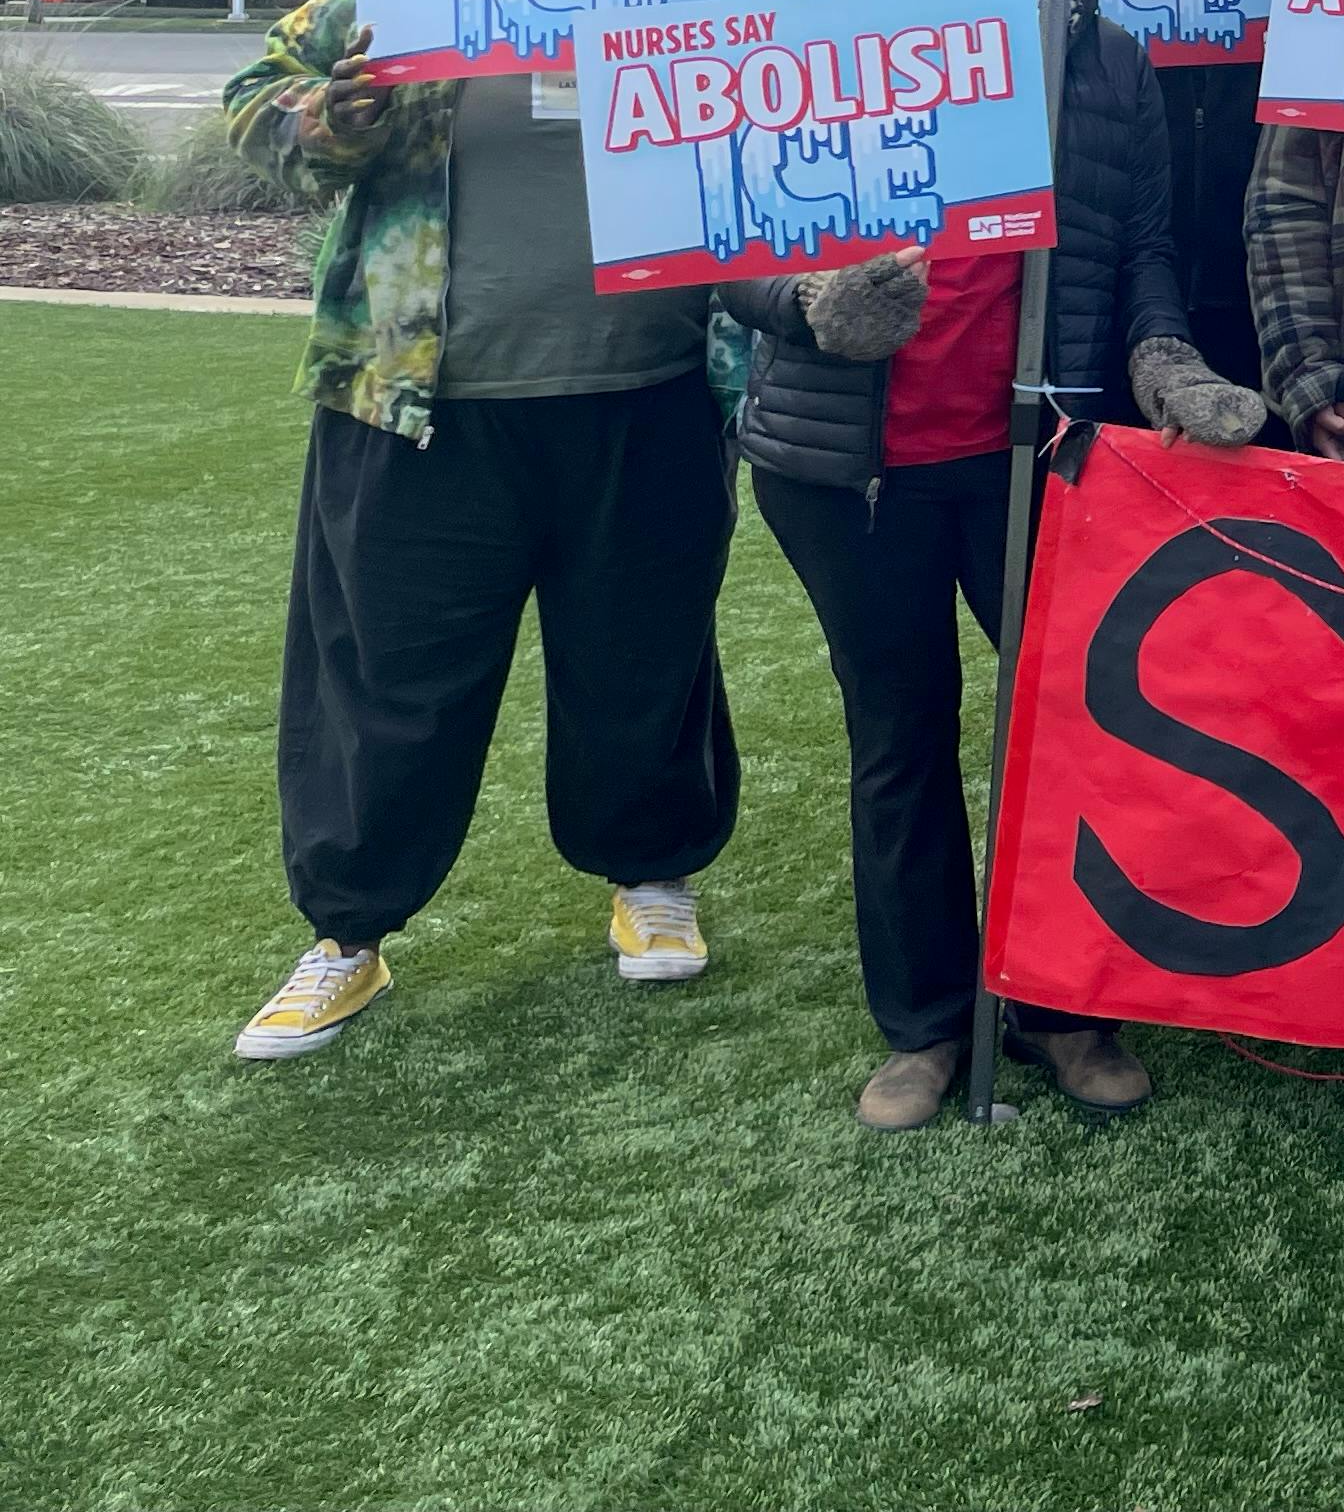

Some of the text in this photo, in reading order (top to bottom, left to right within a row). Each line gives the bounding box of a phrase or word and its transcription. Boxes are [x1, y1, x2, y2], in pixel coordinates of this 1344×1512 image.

[602, 11, 777, 61] NURSES SAY
[604, 17, 1015, 152] ABOLISH
[694, 108, 944, 262] ICE
